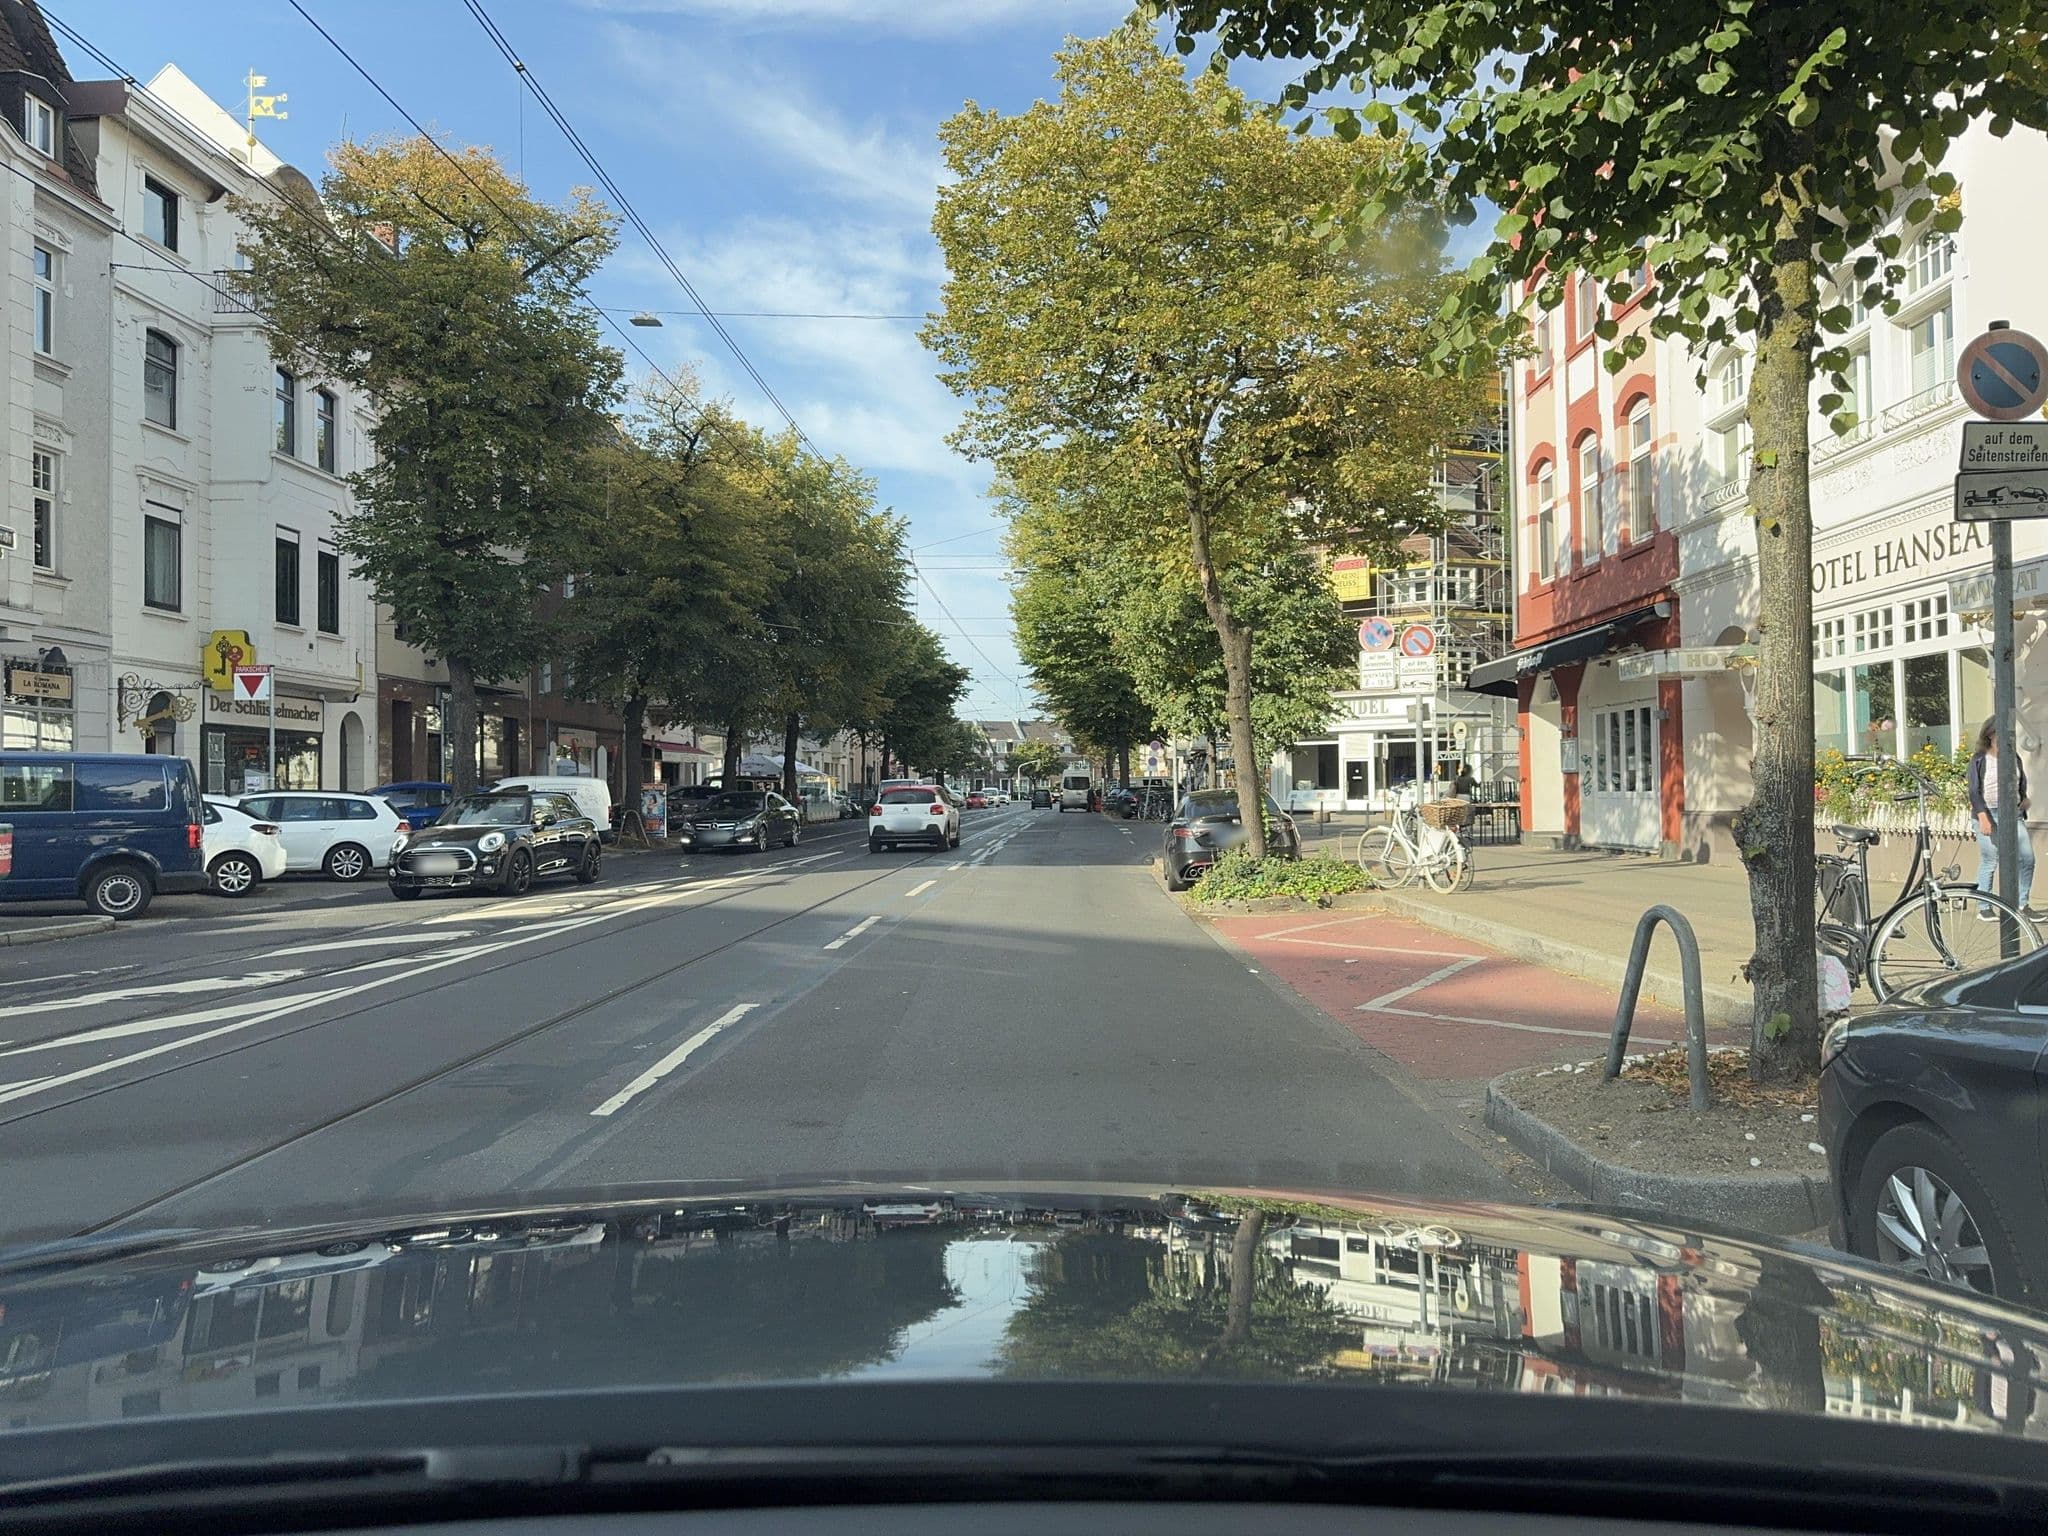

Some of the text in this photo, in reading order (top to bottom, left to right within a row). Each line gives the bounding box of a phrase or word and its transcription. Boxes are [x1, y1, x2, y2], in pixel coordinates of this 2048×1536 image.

[1985, 432, 2033, 444] auf dem
[1968, 448, 2048, 462] Seitenstreifen
[1811, 550, 1867, 594] OTEL
[1686, 654, 1718, 668] HO
[23, 679, 32, 687] LA
[209, 694, 320, 721] Der Schlüselmacher
